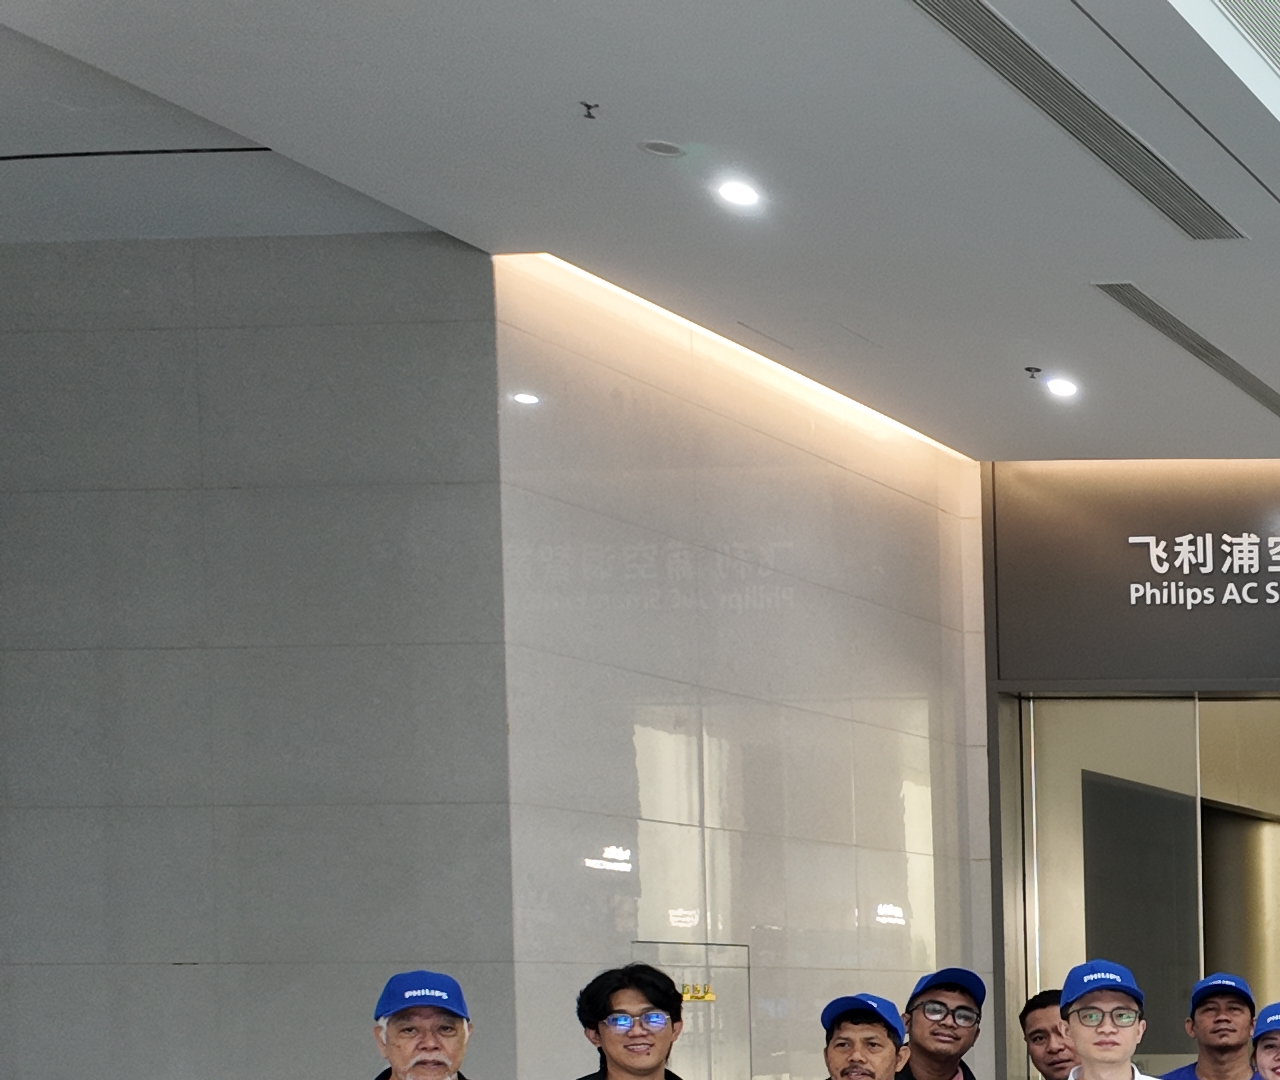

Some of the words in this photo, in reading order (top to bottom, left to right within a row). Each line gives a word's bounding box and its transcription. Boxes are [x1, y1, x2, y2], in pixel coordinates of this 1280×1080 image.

[1129, 581, 1215, 610] Philips
[1222, 582, 1258, 605] AC
[404, 988, 449, 1000] PHILIPS
